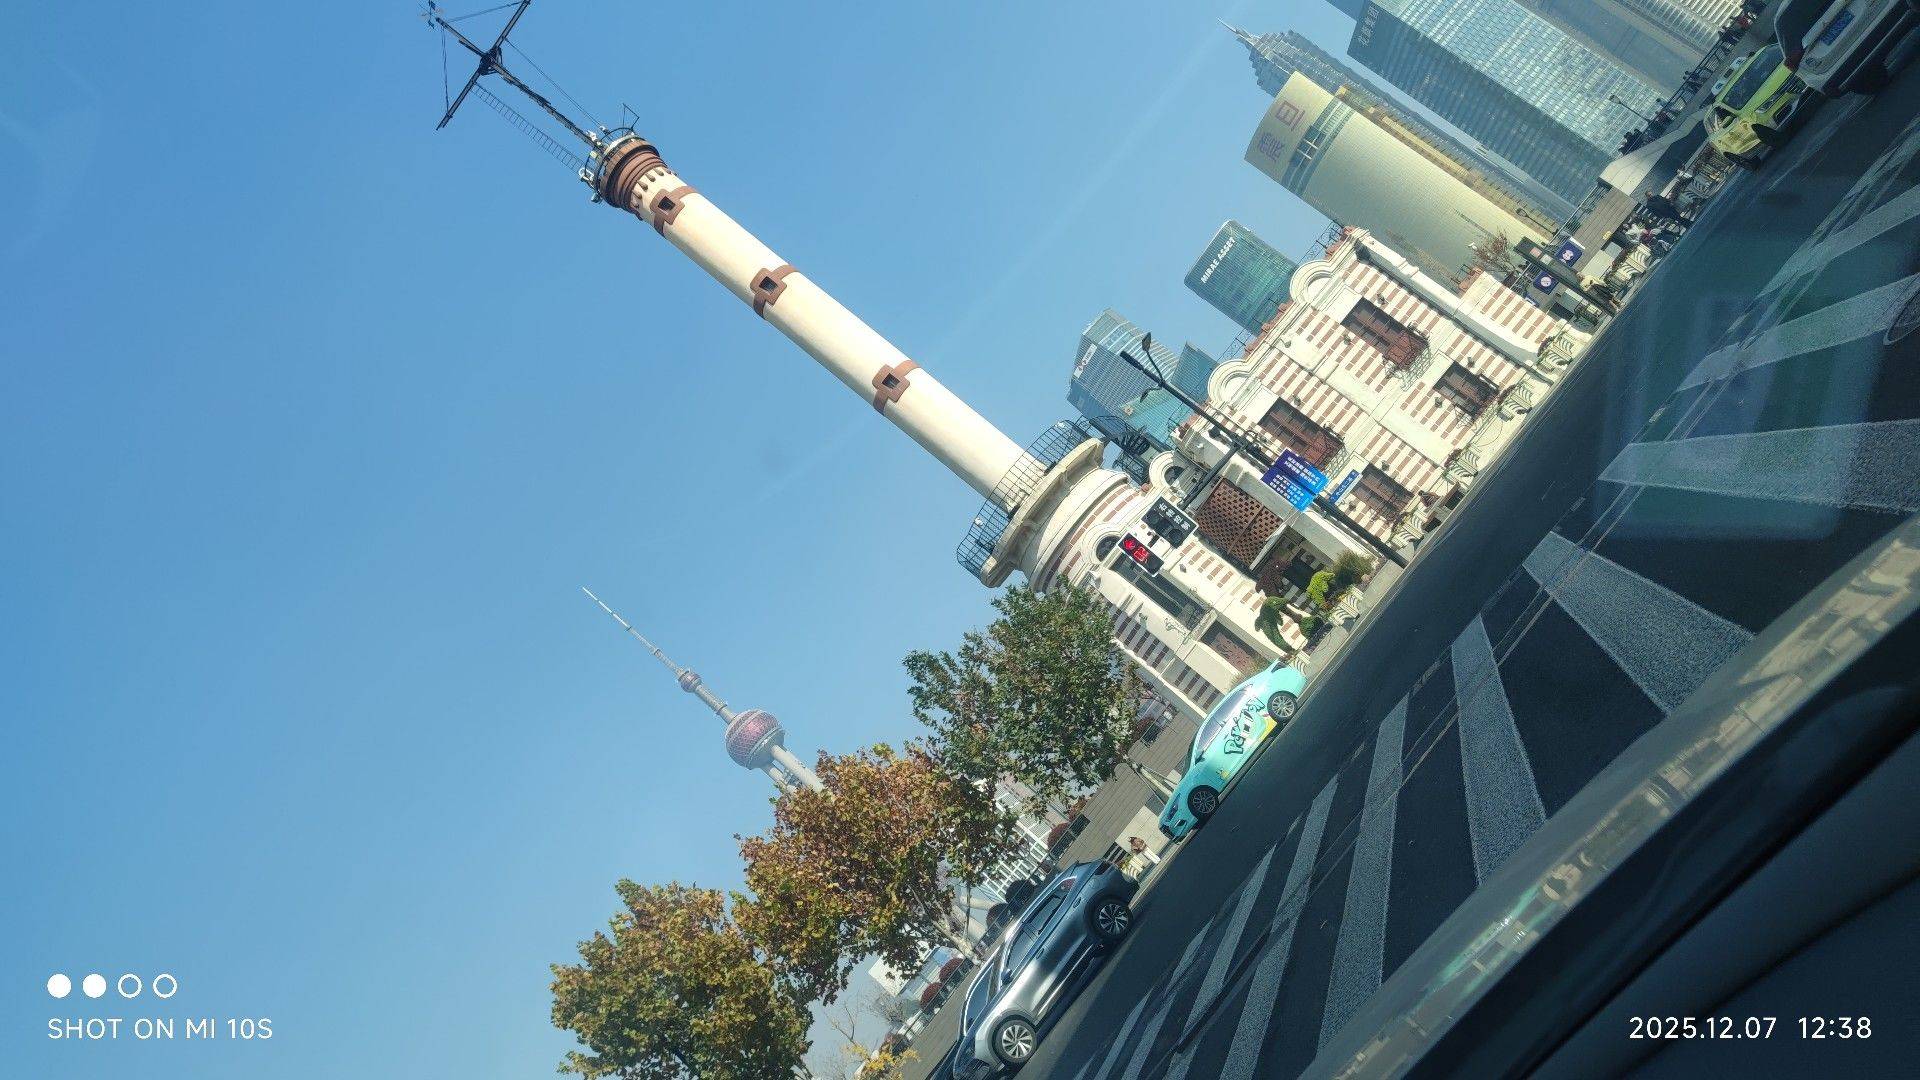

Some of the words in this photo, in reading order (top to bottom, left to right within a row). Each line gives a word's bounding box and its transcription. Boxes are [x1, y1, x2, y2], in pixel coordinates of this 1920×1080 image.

[1200, 259, 1221, 284] MIRAE
[1217, 236, 1237, 260] ASSET
[1157, 502, 1191, 531] 右转控制
